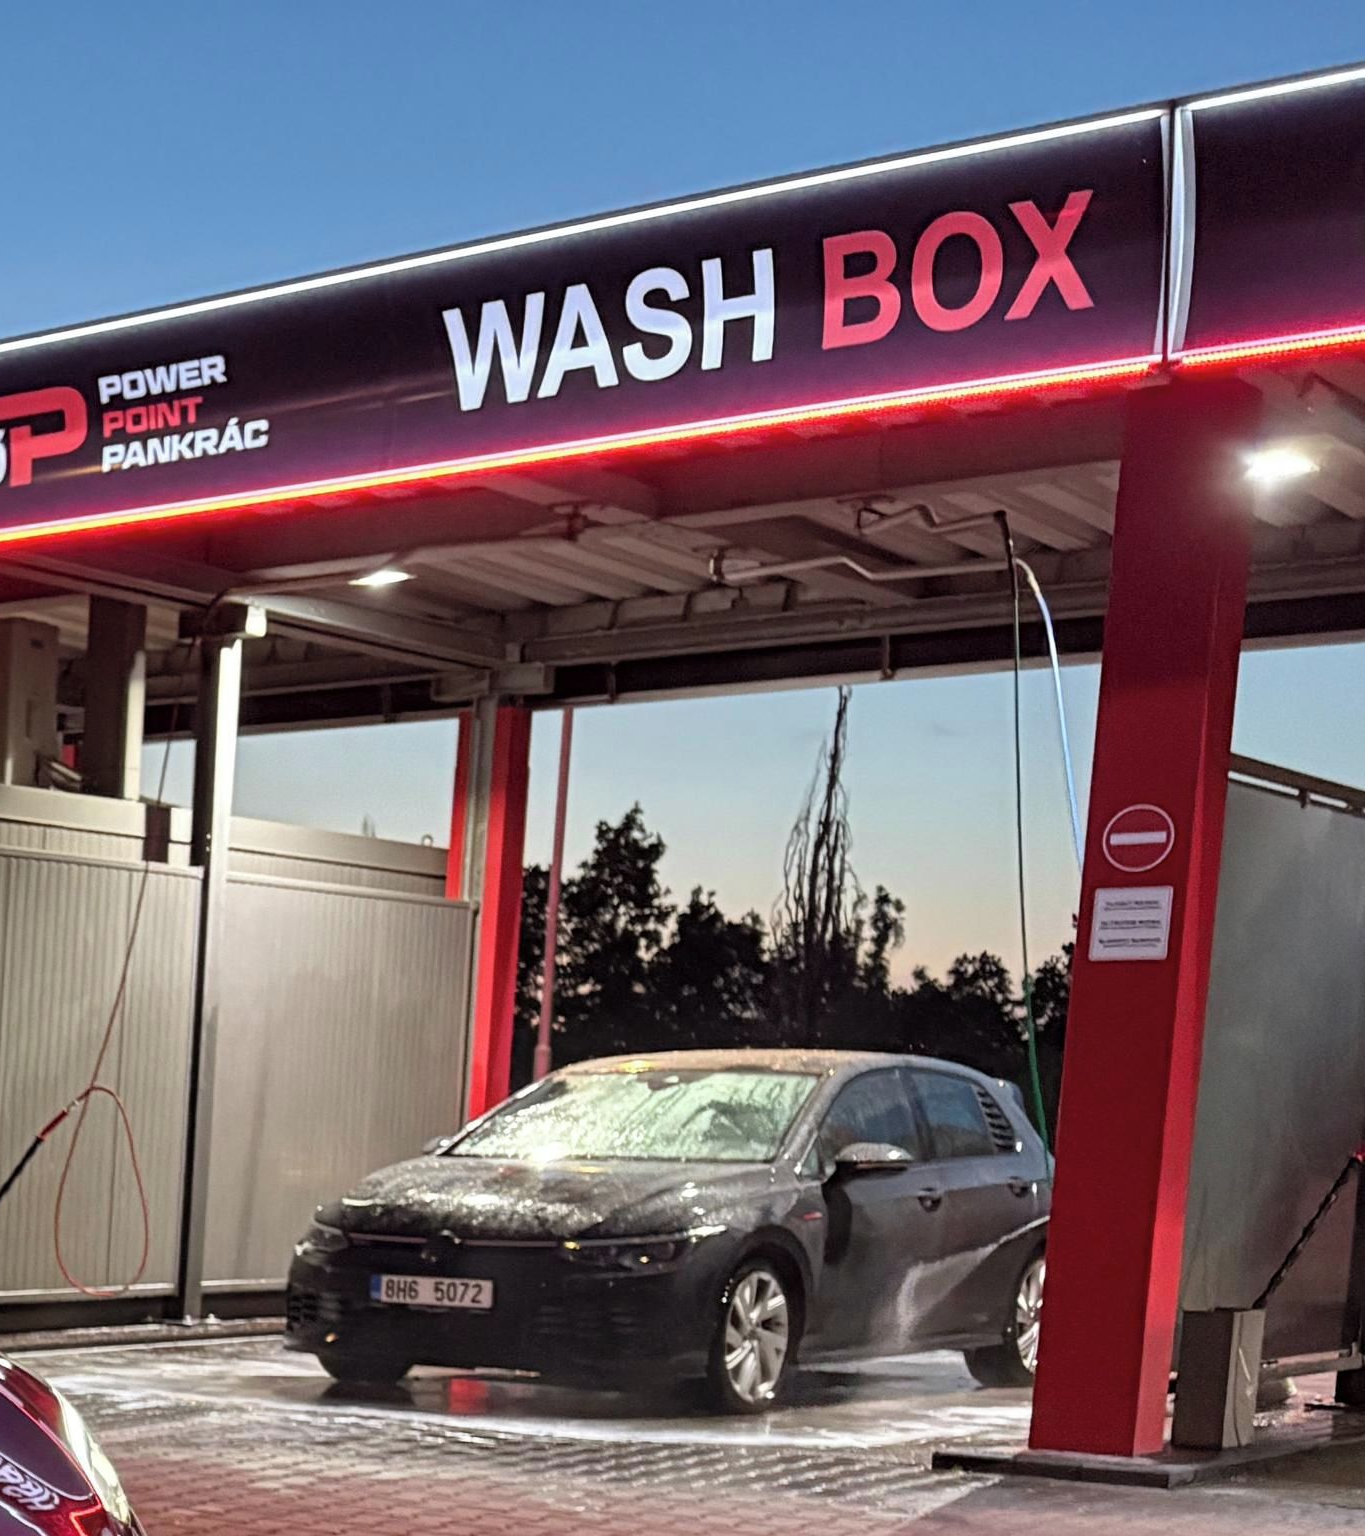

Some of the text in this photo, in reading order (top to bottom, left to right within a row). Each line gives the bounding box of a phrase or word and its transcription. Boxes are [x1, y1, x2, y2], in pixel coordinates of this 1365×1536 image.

[441, 191, 1097, 413] WASH BOX
[99, 356, 226, 405] POWER
[101, 395, 204, 438] POINT
[100, 416, 268, 472] PANKRÁC
[385, 1279, 419, 1302] 8H6
[434, 1281, 483, 1304] 5072
